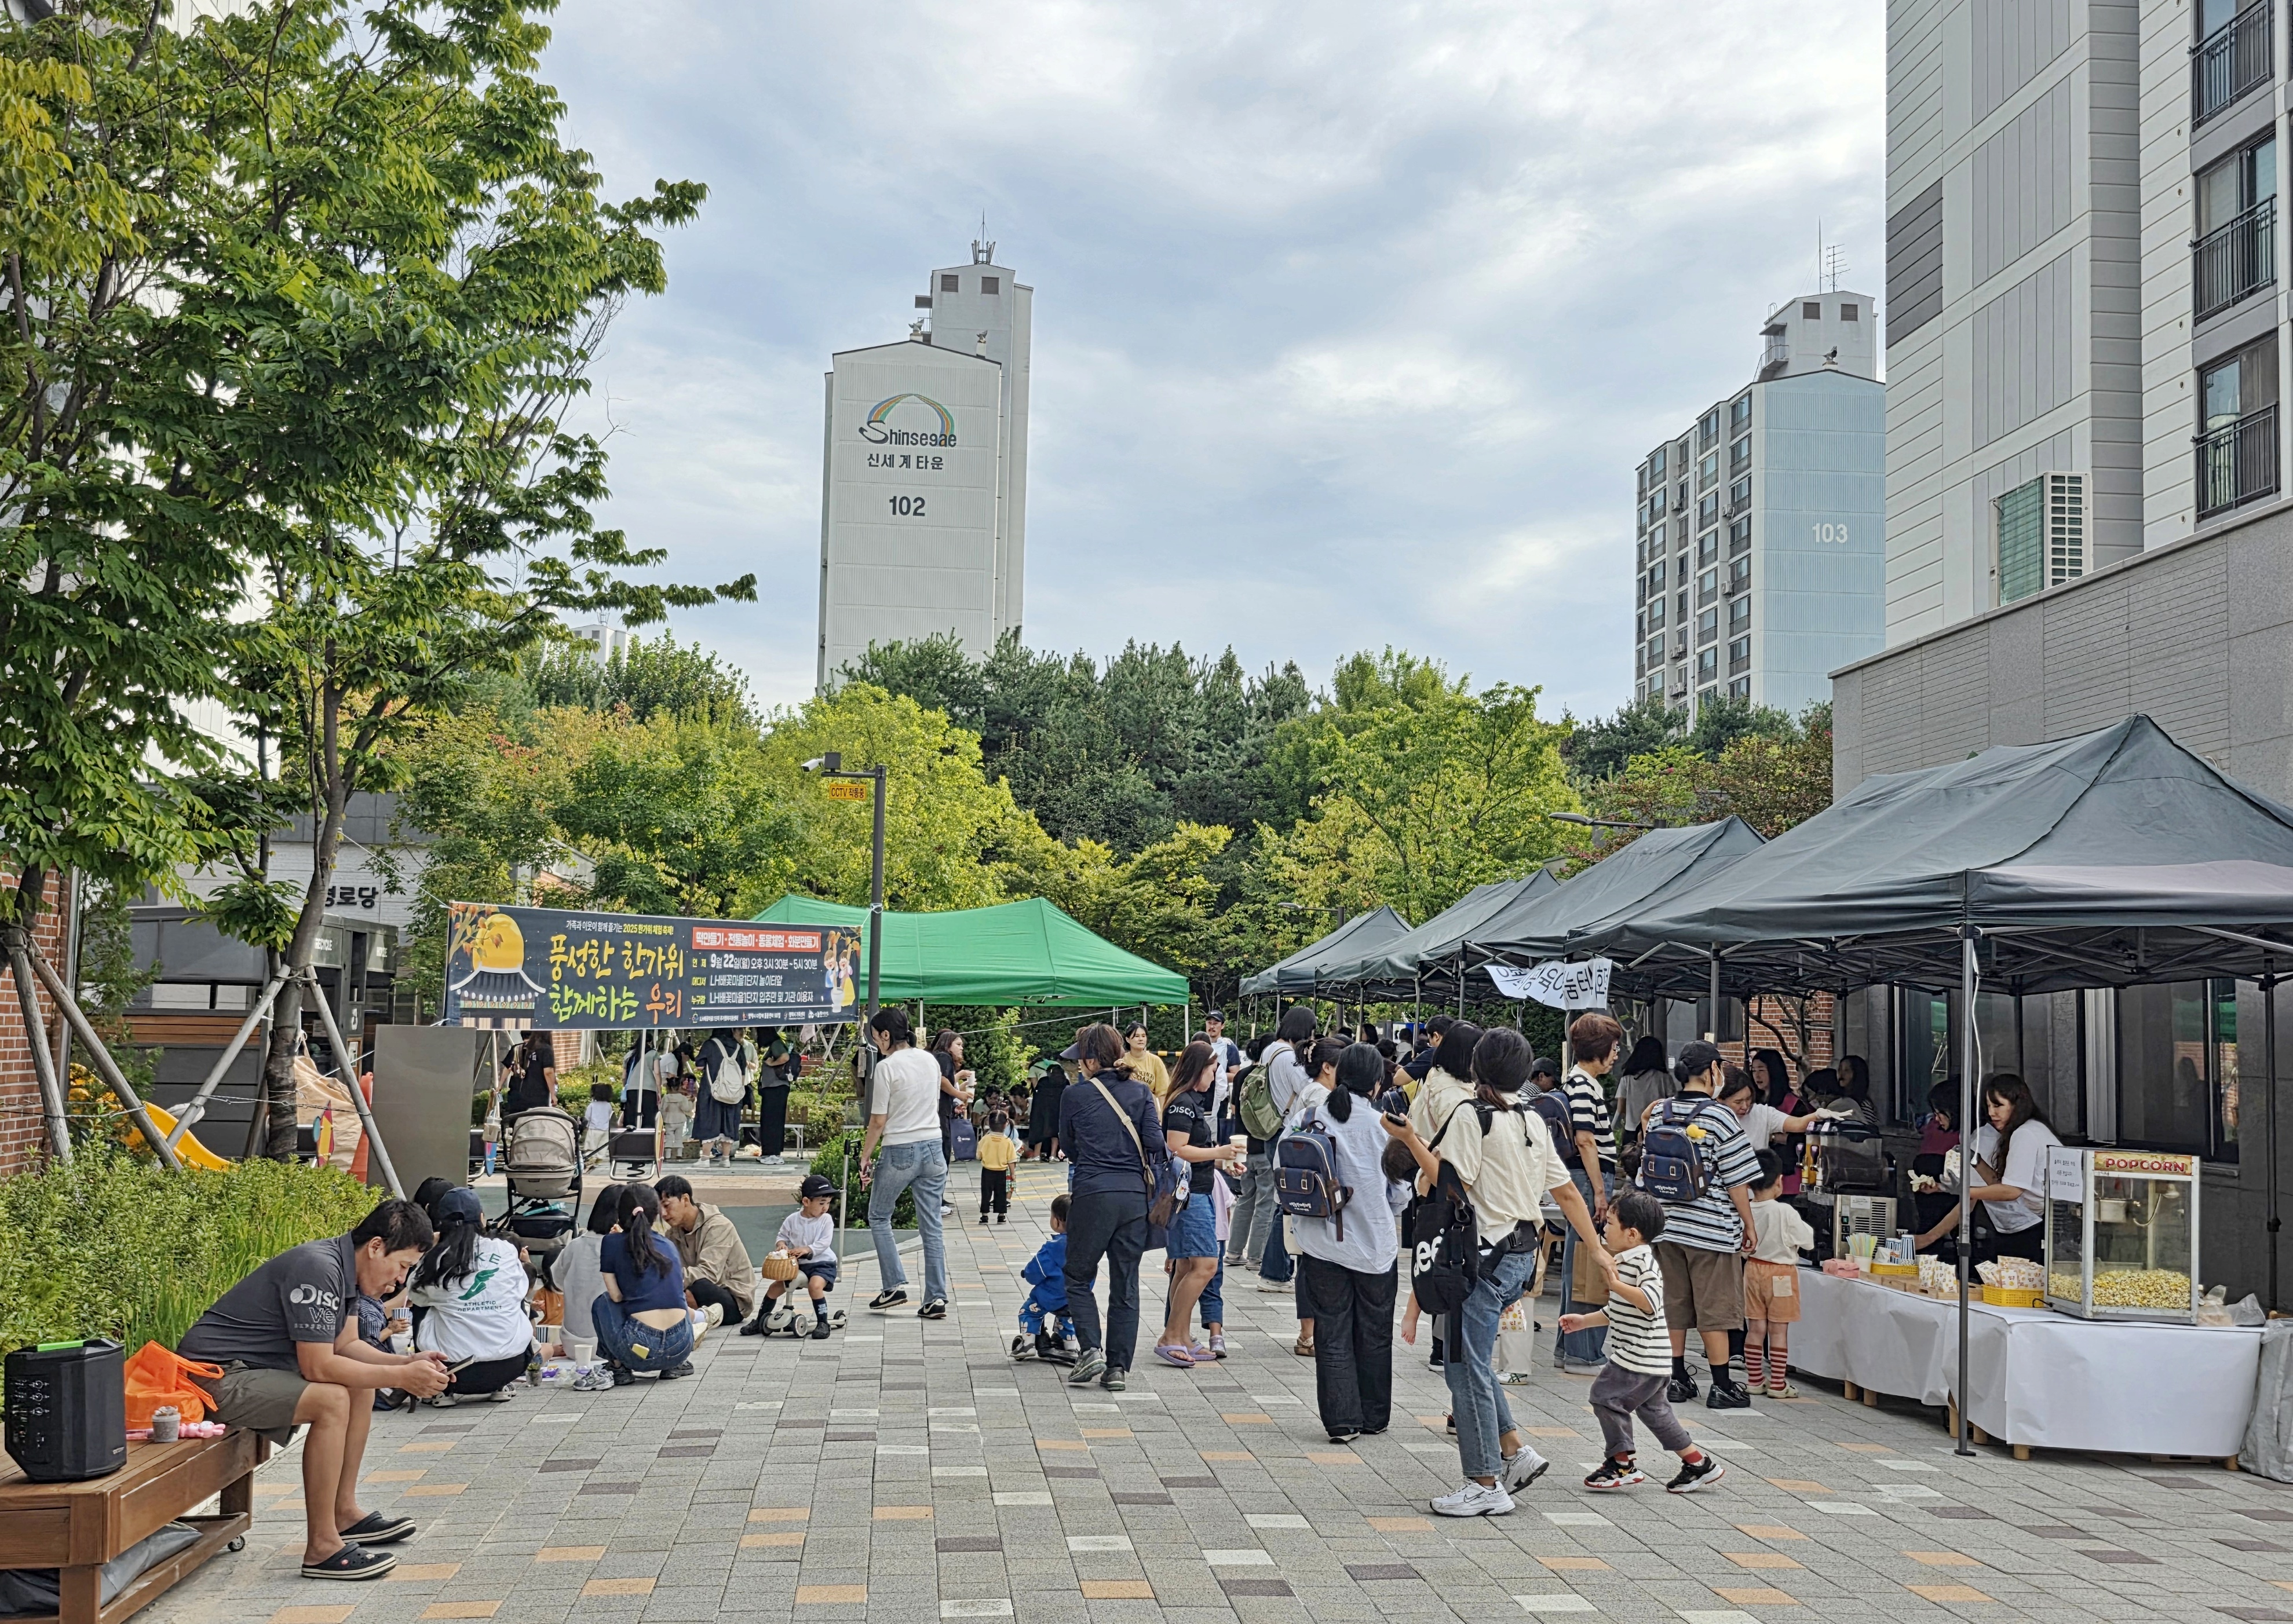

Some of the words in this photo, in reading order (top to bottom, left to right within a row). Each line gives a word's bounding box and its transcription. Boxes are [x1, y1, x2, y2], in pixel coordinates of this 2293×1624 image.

[858, 420, 957, 447] Shinsegae
[889, 496, 926, 517] 102
[1812, 522, 1848, 543] 103
[831, 788, 848, 797] CCTV
[849, 788, 865, 798] 작동중
[566, 920, 582, 931] 가족과
[582, 921, 597, 931] 이웃이
[597, 921, 608, 932] 함께
[608, 923, 623, 933] 즐기는
[623, 923, 637, 934] 2025
[638, 924, 653, 934] 한가위
[653, 924, 662, 935] 체험
[662, 925, 674, 935] 축제!
[315, 938, 333, 951] RECYCLE
[550, 934, 615, 982] 풍성한
[622, 941, 684, 980] 한가위
[710, 953, 722, 969] 9월
[724, 953, 750, 969] 22일(월)
[751, 959, 763, 970] 오후
[764, 959, 774, 970] 3시
[804, 959, 818, 970] 30분
[692, 976, 706, 986] 어디서
[710, 974, 758, 986] LH배꽃마을1단지
[759, 975, 783, 986] 놀이터앞
[549, 983, 640, 1023] 함께하는
[645, 982, 682, 1025] 우리
[691, 995, 706, 1005] 누구랑
[710, 992, 758, 1004] LH배꽃마을1단지
[759, 992, 777, 1003] 입주민
[777, 992, 784, 1003] 및
[784, 991, 796, 1003] 기관
[797, 991, 813, 1003] 이용자
[1169, 1104, 1195, 1118] DISCO
[2105, 1158, 2185, 1172] POPCORN
